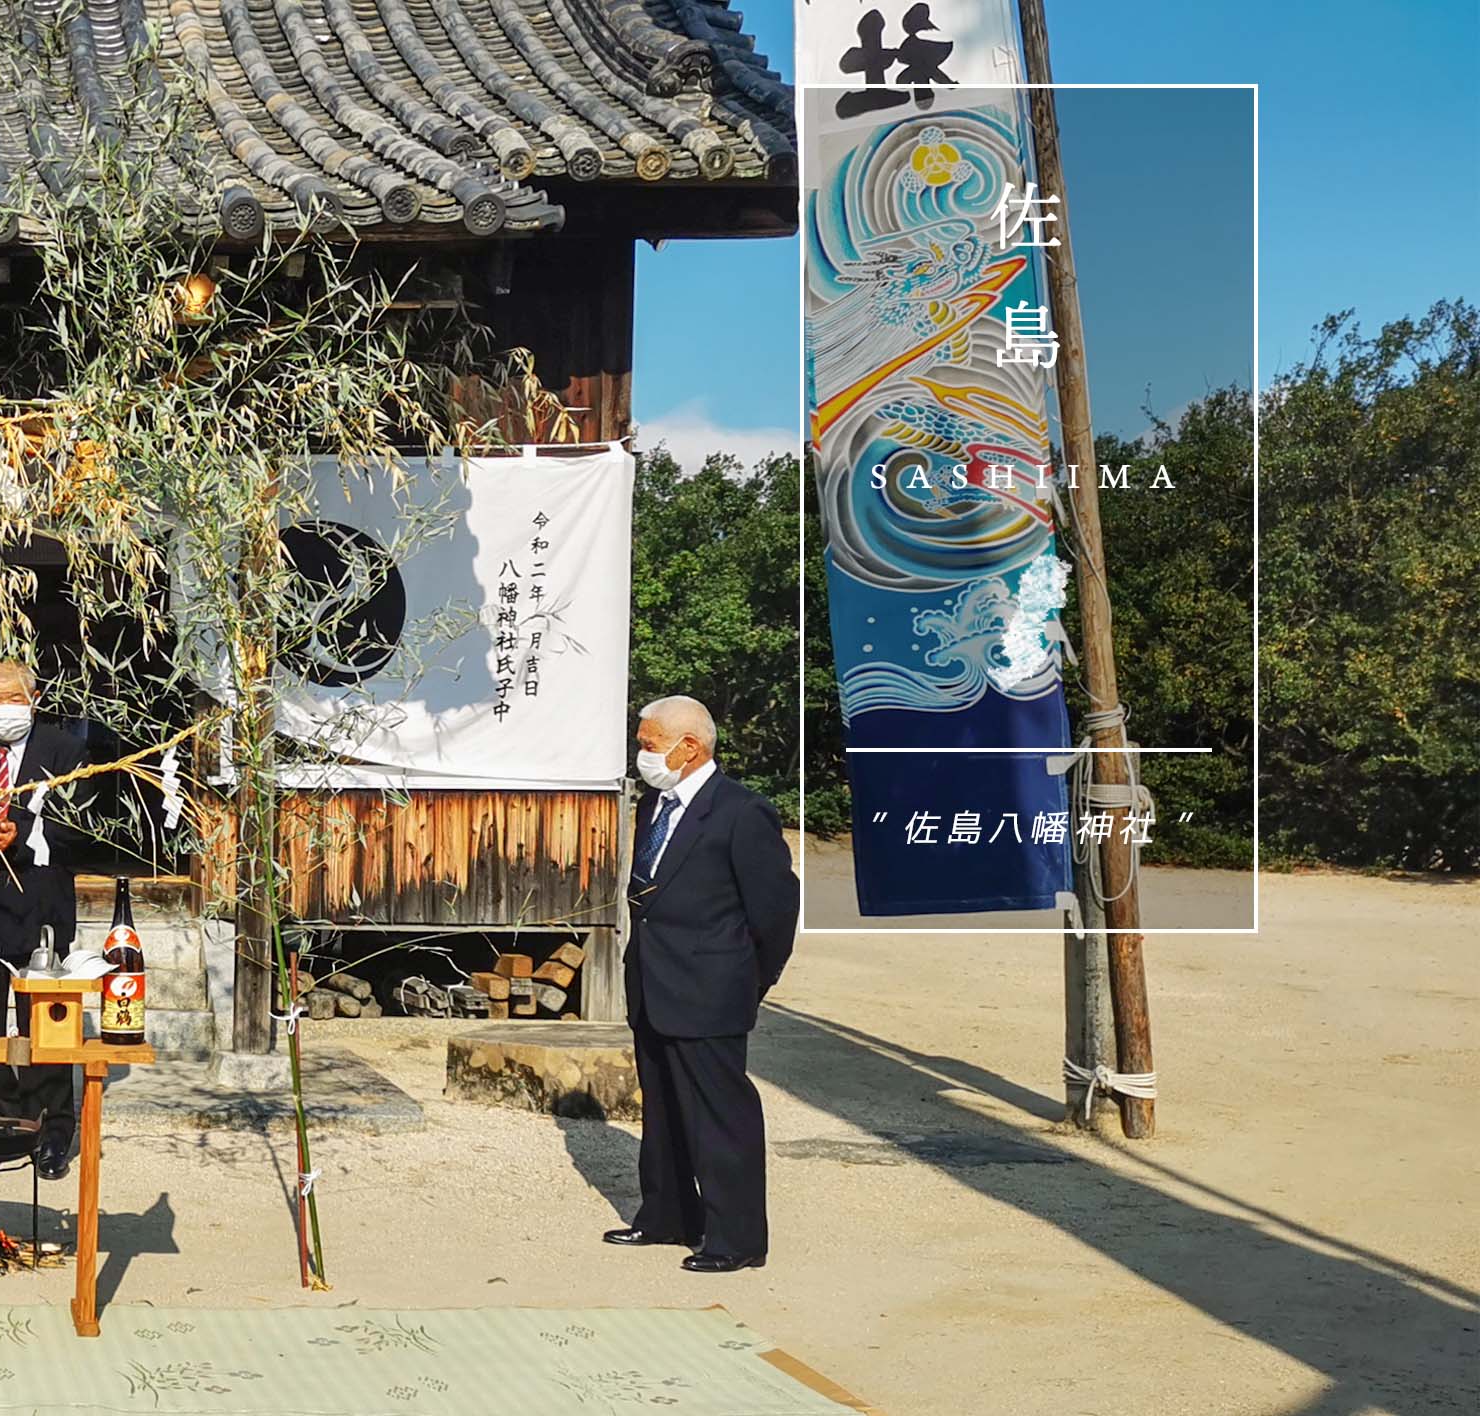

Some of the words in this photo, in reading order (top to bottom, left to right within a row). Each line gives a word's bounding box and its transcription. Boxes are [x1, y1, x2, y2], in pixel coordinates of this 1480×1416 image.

[493, 559, 522, 723] 八幡神社氏子中
[524, 511, 550, 697] 令和二年一月吉日
